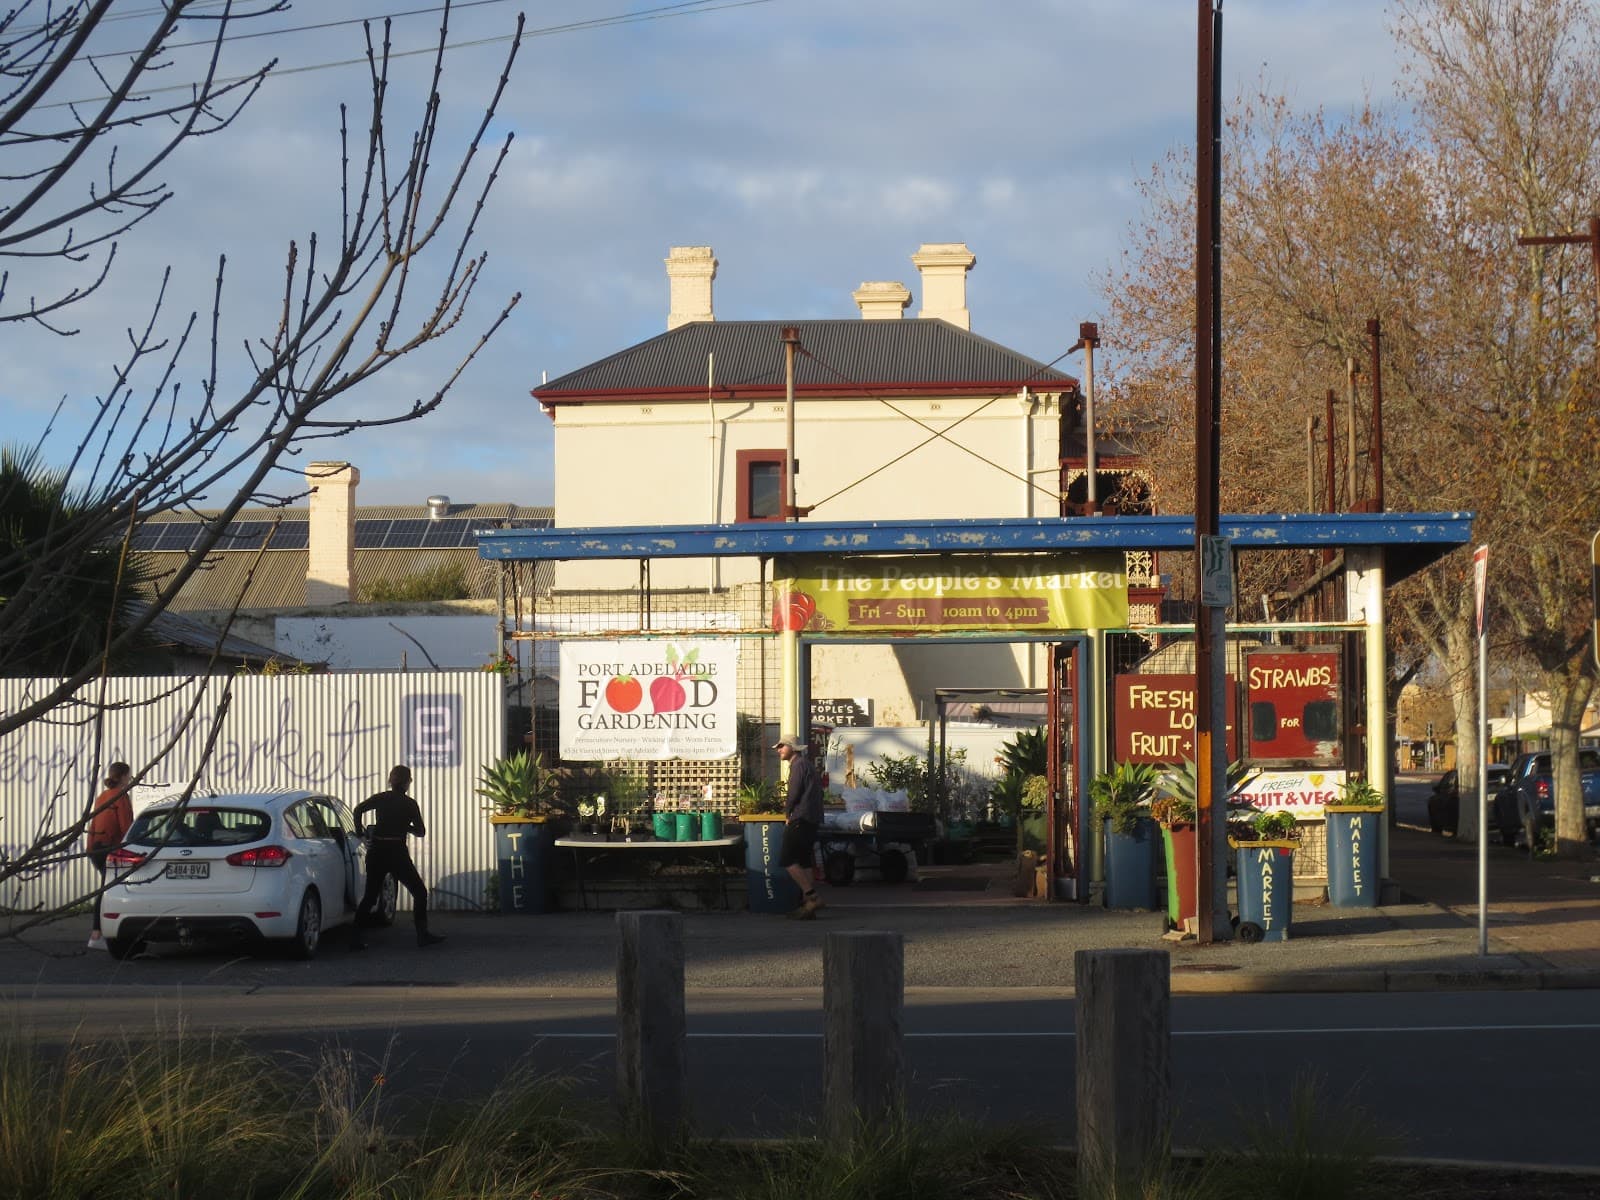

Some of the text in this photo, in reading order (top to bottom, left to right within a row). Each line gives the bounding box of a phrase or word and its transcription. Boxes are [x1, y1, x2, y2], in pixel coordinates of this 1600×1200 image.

[816, 563, 1123, 597] The People's Market
[859, 605, 881, 618] Fri
[896, 605, 926, 618] Sun
[943, 606, 982, 617] 10am
[986, 605, 1000, 617] to
[1004, 606, 1038, 619] 4pm
[578, 663, 718, 676] PORT ADELAIDE
[1249, 666, 1331, 690] STRAWBS
[811, 704, 854, 714] EOPLE'S
[1129, 685, 1194, 710] FRESH
[577, 713, 717, 730] GARDENING
[1280, 717, 1300, 729] FOR
[1131, 731, 1182, 756] FRUIT
[1261, 777, 1305, 791] FRESH
[1349, 816, 1363, 897] MARKET
[506, 832, 525, 908] THE
[1258, 847, 1275, 931] MARKET
